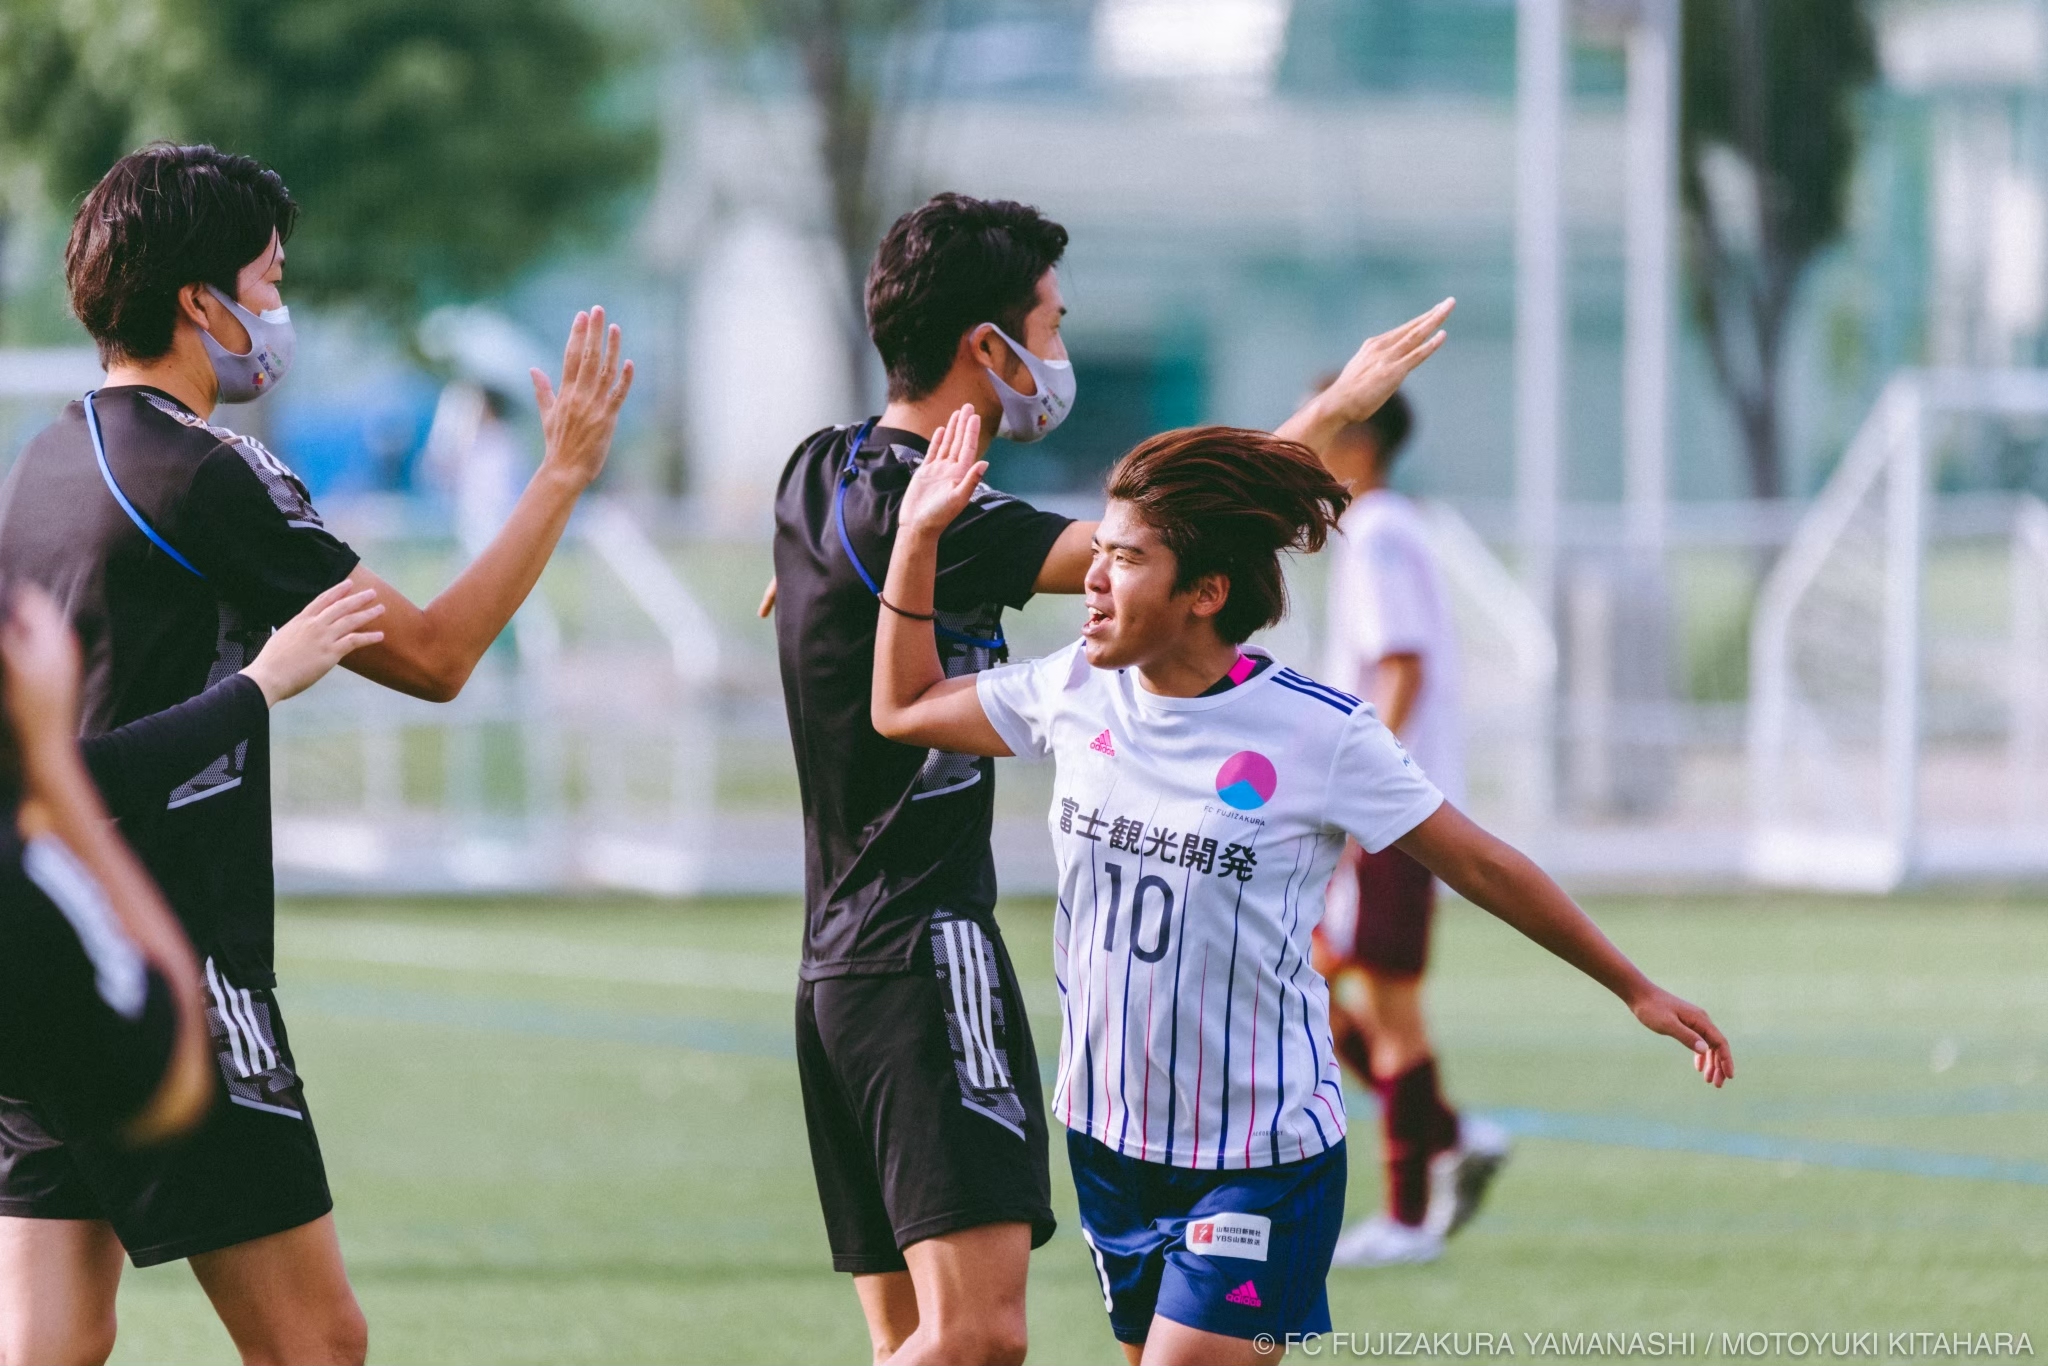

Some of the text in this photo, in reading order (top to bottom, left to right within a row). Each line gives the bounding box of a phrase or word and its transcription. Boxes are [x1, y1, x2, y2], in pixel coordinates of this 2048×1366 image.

[1090, 741, 1115, 757] adidas
[1204, 805, 1266, 826] FC FUJIZAKURA
[1060, 797, 1258, 882] 富士観光開発
[1103, 862, 1174, 964] 10
[1251, 1129, 1284, 1137] AERORDY
[1225, 1293, 1262, 1308] adidas
